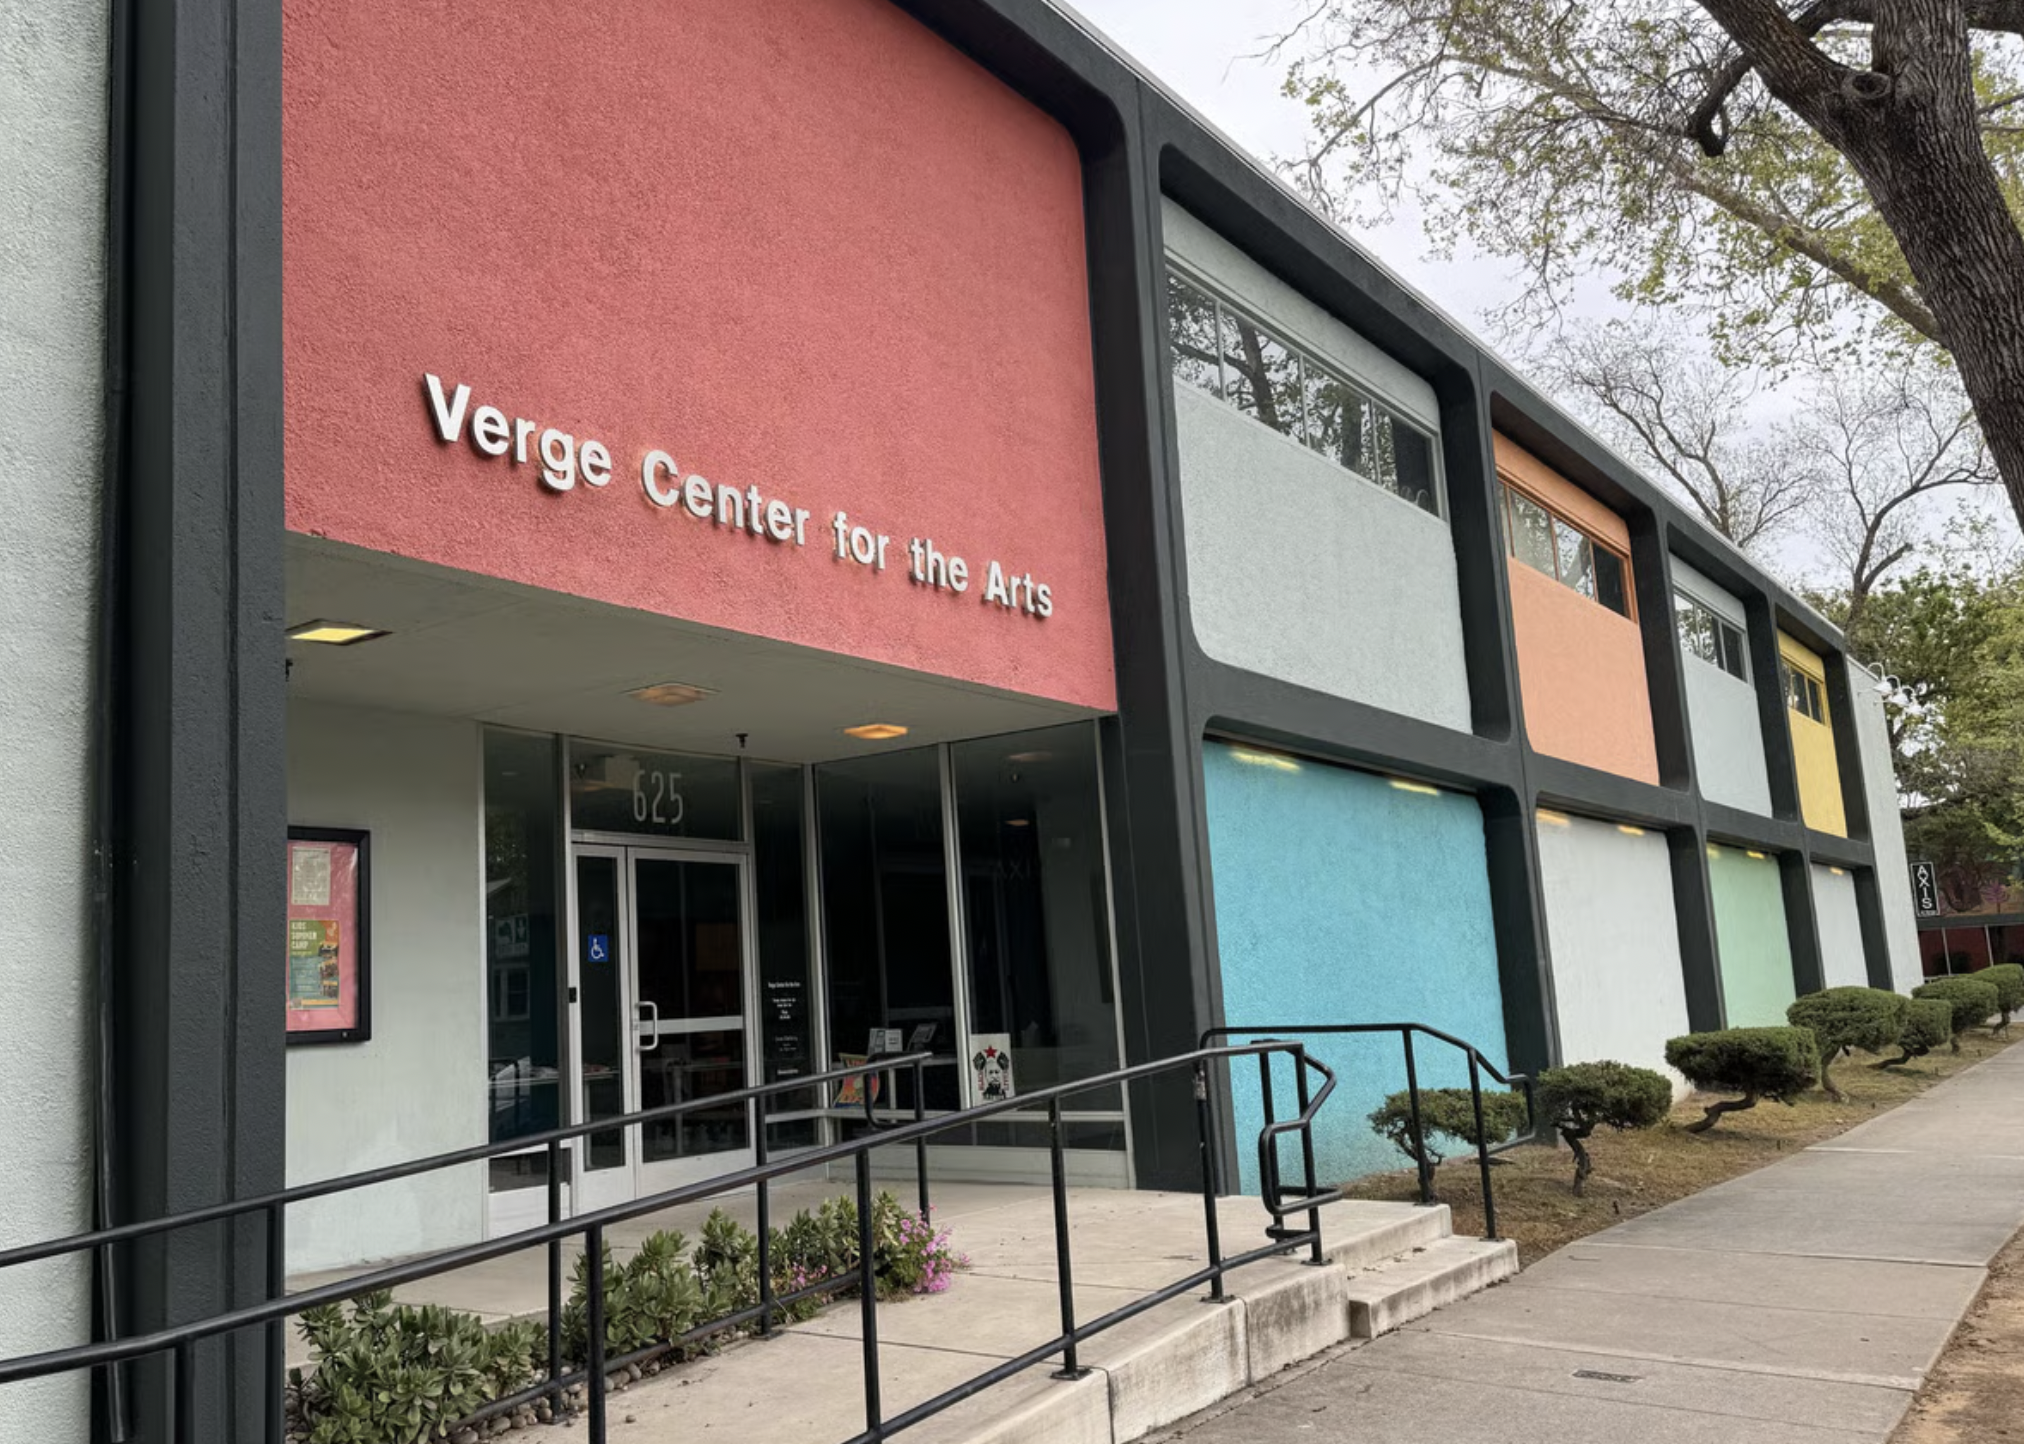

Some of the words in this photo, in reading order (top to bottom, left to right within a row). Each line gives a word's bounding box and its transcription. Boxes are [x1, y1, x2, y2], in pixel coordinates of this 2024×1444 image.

[423, 372, 612, 491] Verge
[641, 449, 810, 546] Center
[833, 510, 890, 570] for
[909, 537, 968, 592] the
[983, 560, 1053, 618] Arts
[632, 769, 684, 825] 625
[1917, 865, 1933, 909] AXIS
